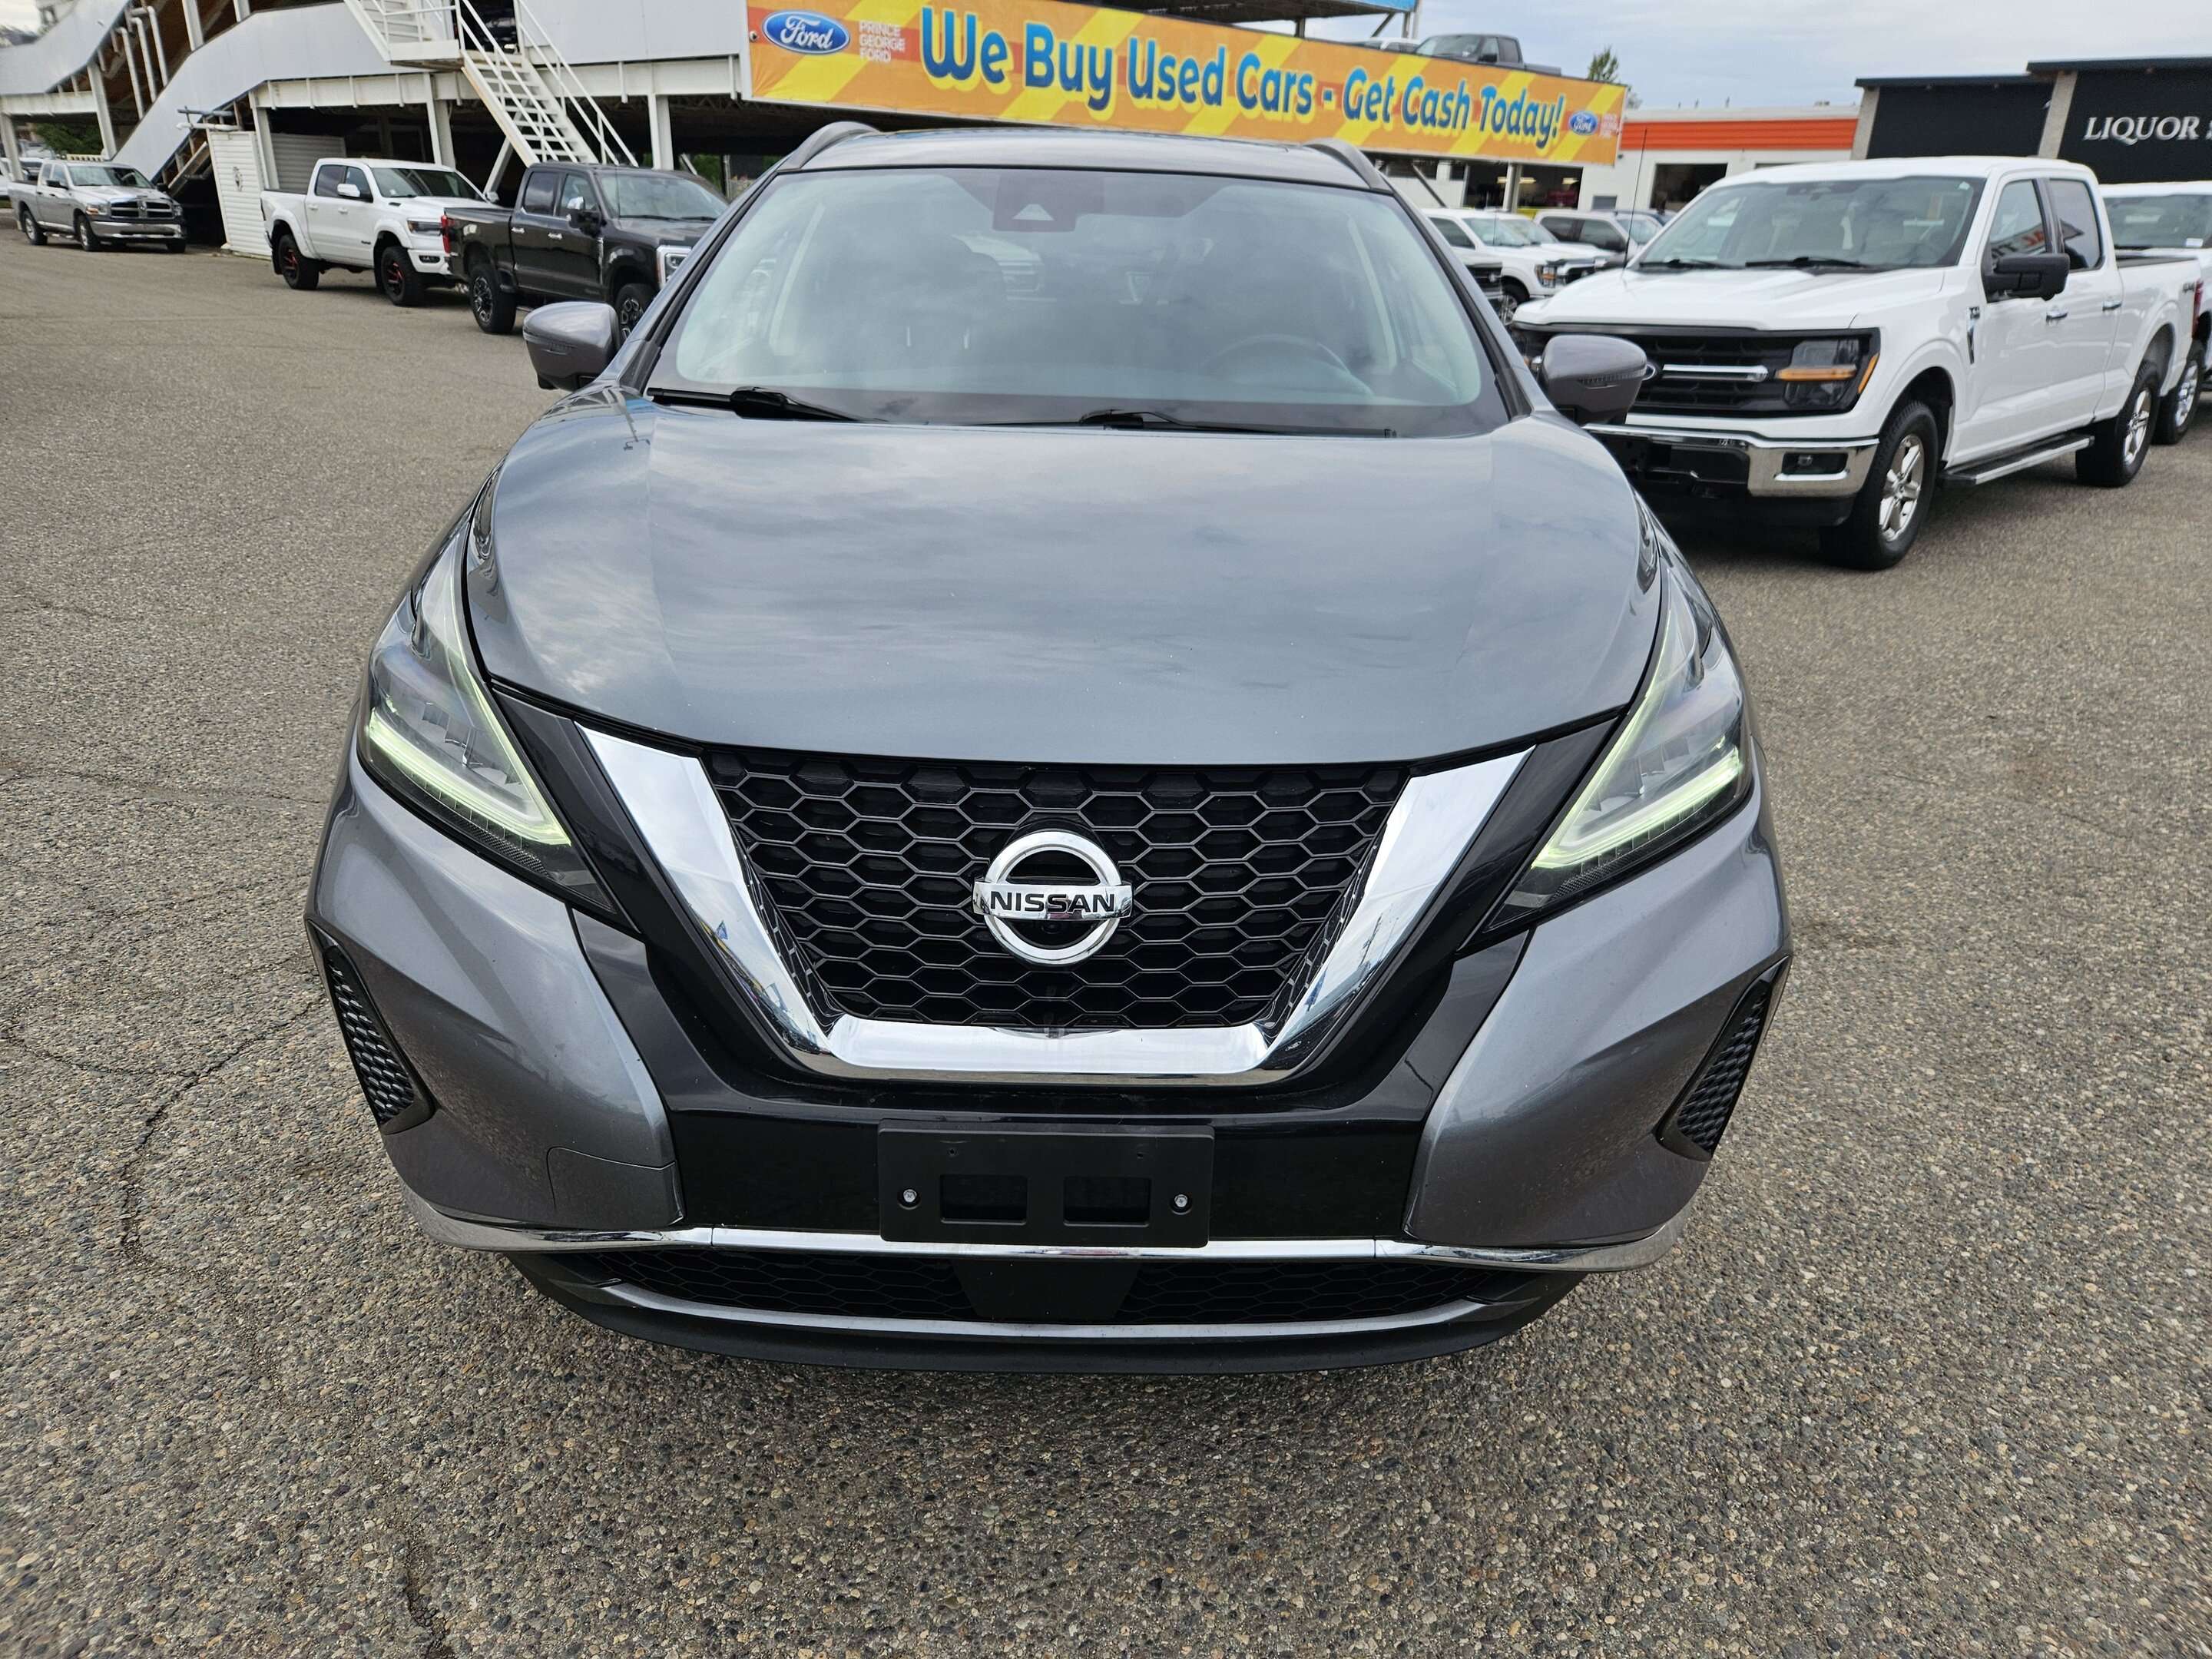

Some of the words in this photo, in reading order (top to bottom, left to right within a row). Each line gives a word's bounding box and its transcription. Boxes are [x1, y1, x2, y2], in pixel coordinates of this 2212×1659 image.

[780, 15, 835, 49] Ford
[859, 21, 901, 37] PRINCE
[859, 34, 905, 51] GEORGE
[859, 48, 891, 62] FORD
[922, 6, 1008, 84] We
[1025, 22, 1113, 111] Buy
[1128, 36, 1225, 107] Used
[1236, 51, 1314, 115] Cars
[1344, 67, 1395, 124] Get
[1401, 75, 1471, 131] Cash
[1479, 84, 1565, 150] Today!
[2083, 116, 2200, 145] LIQUOR
[990, 890, 1115, 913] NISSAN
